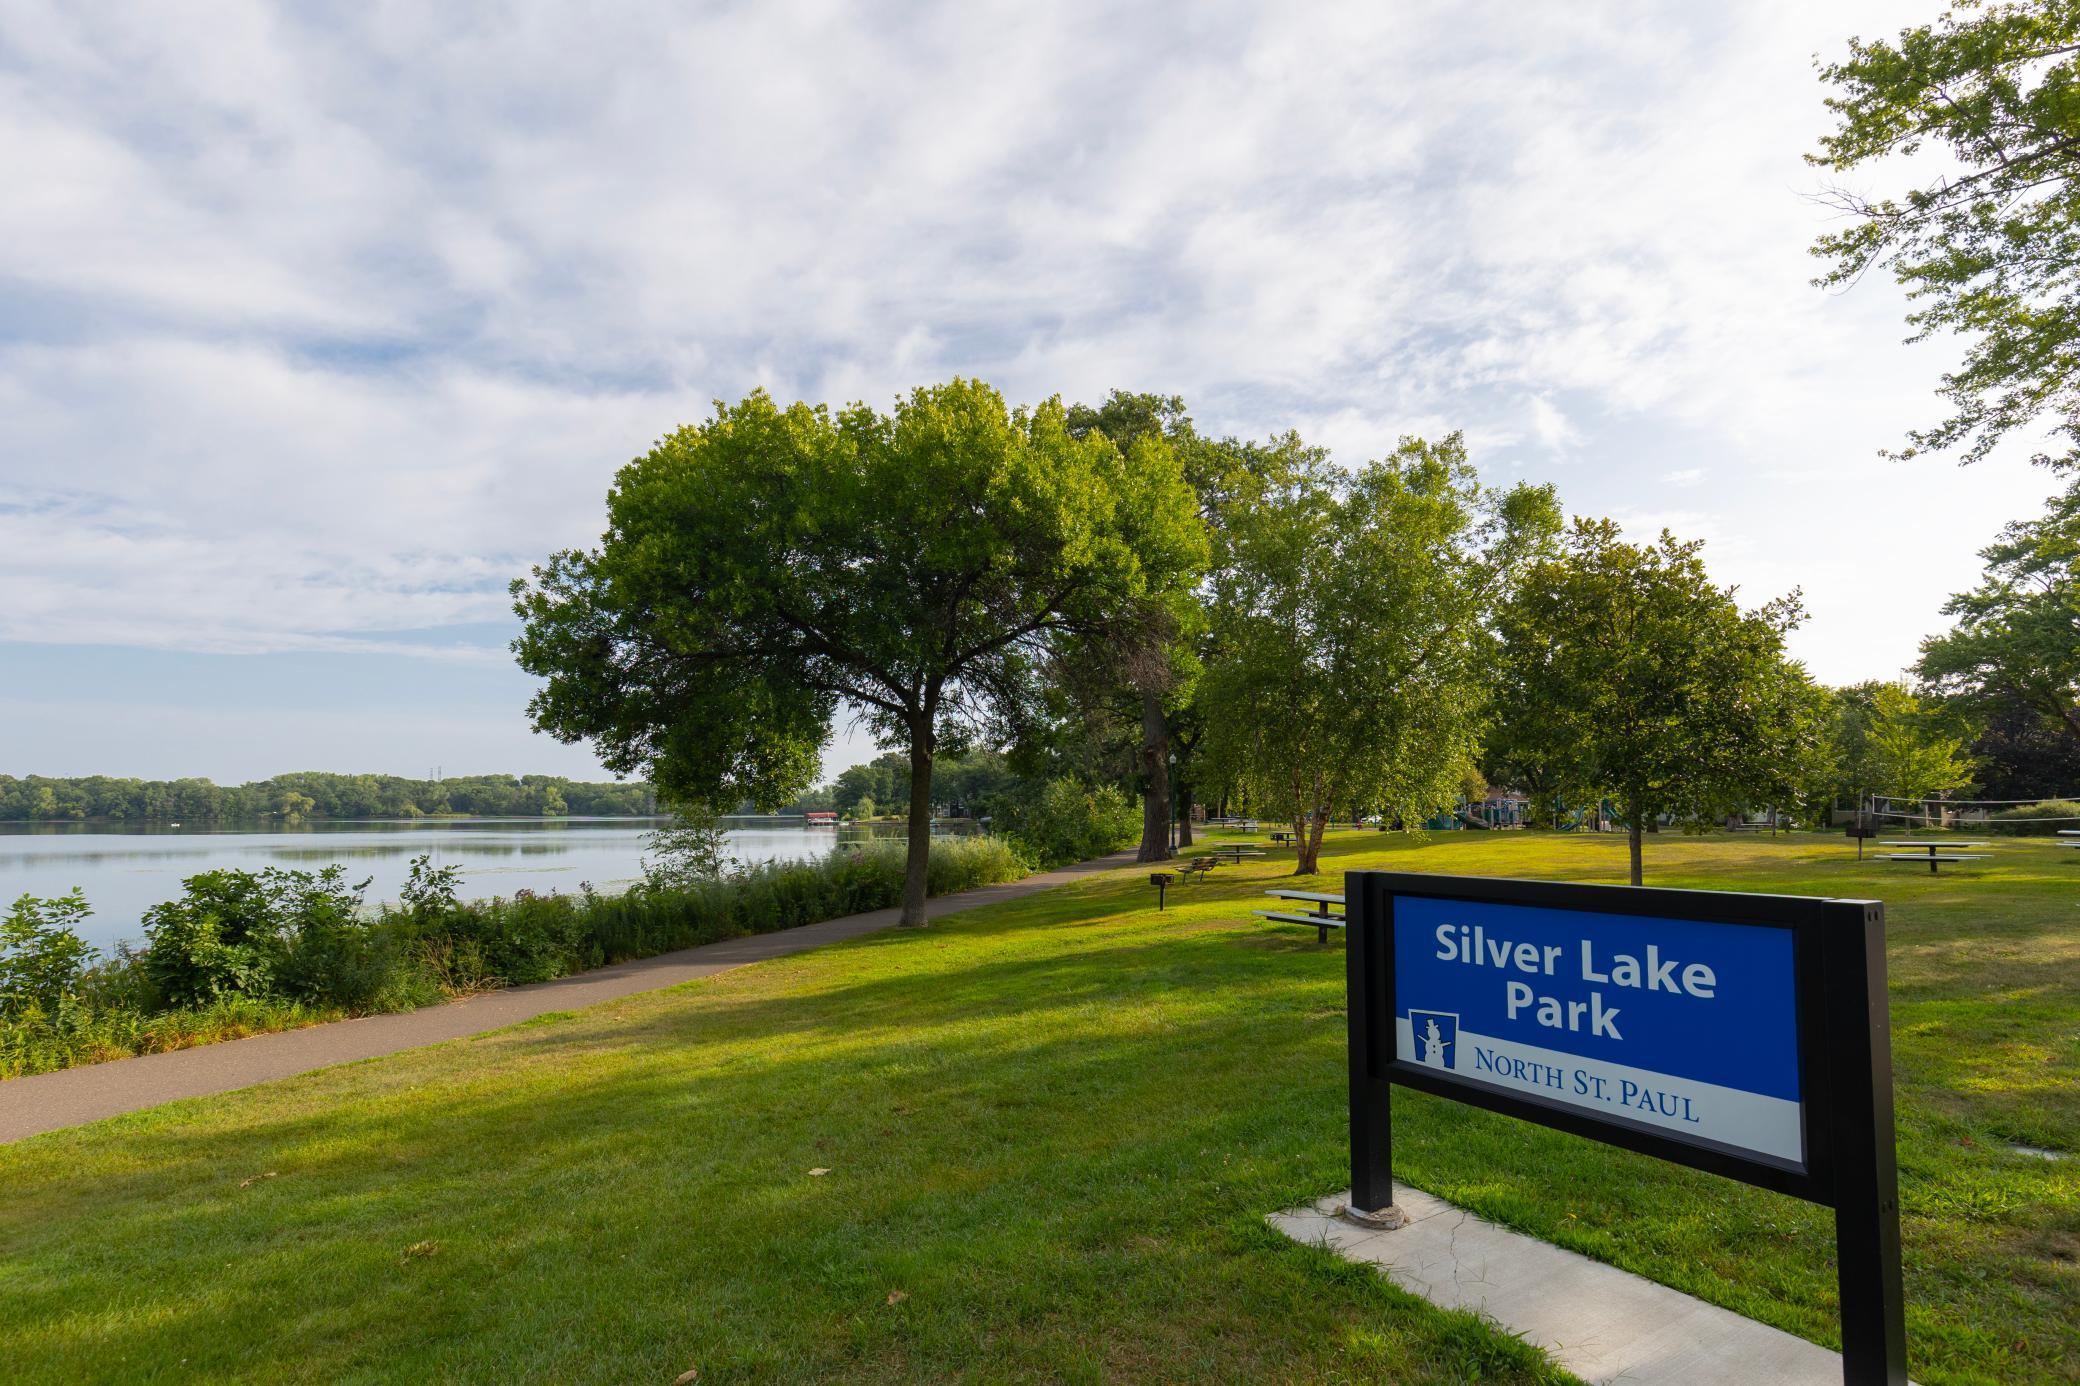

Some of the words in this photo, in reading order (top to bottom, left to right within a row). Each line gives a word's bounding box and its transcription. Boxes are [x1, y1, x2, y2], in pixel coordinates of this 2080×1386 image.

[1435, 923, 1562, 976] Silver
[1581, 940, 1717, 999] Lake
[1507, 981, 1624, 1041] Park
[1474, 1046, 1563, 1090] NORTH
[1619, 1079, 1700, 1123] PAUL
